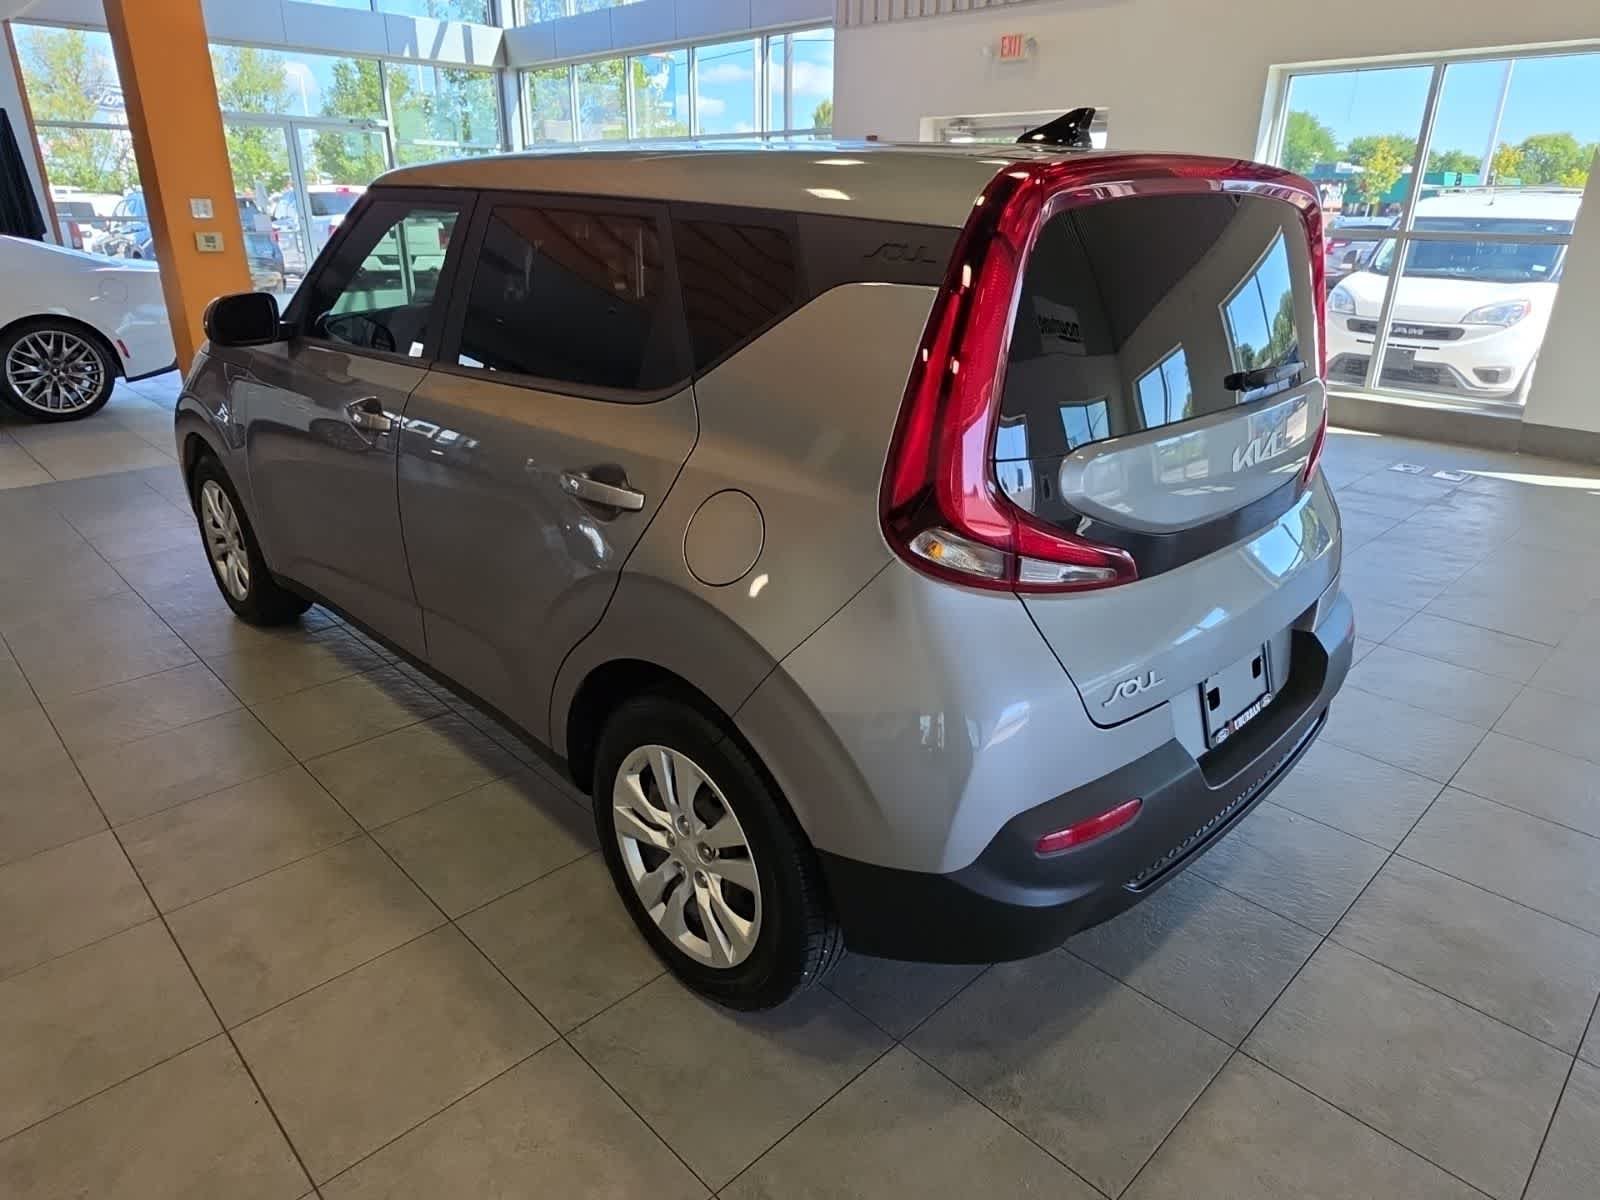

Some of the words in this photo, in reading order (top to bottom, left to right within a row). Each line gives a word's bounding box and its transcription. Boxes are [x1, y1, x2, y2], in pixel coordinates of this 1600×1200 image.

[1000, 35, 1022, 57] EXIT
[863, 242, 937, 264] SOUL
[1101, 671, 1166, 707] SOUL
